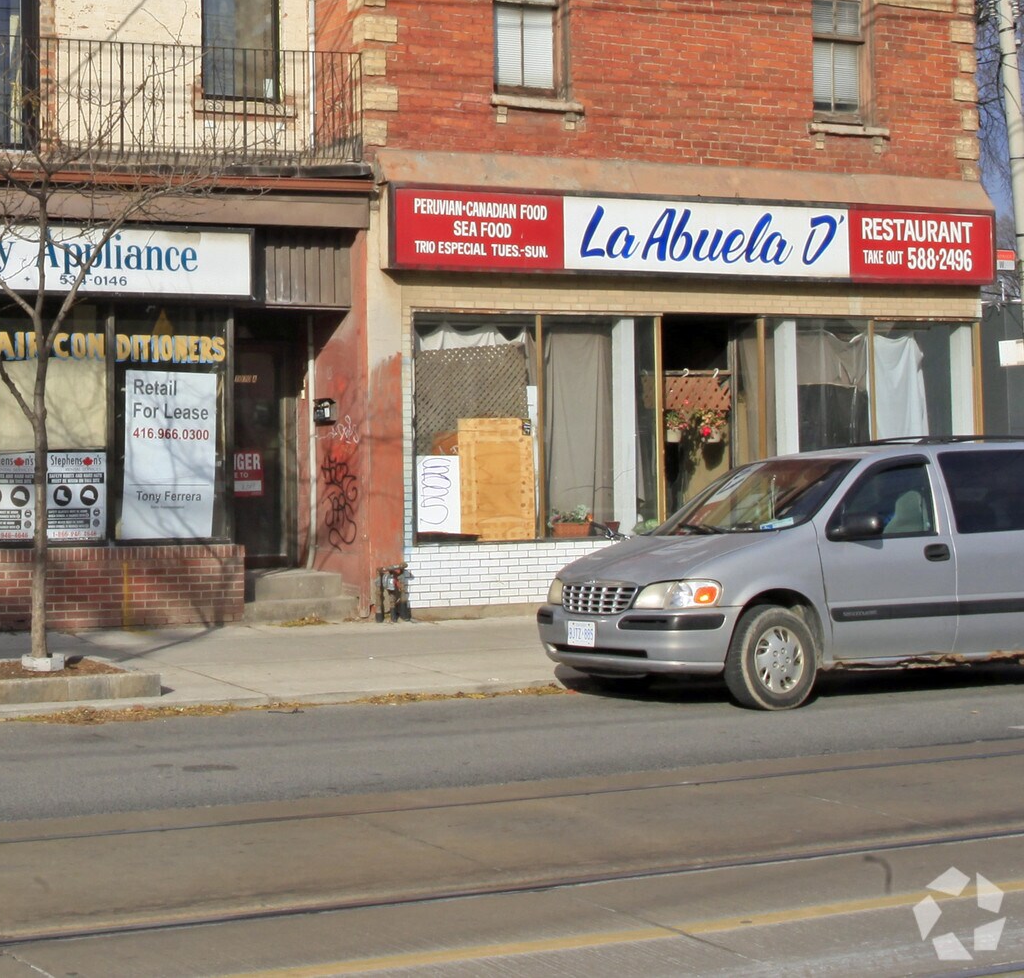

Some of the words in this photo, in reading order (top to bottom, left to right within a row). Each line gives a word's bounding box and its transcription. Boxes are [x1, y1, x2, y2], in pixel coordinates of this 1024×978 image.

[520, 204, 548, 221] FOOD
[453, 220, 478, 237] SEA
[480, 222, 512, 238] FOOD
[580, 205, 640, 260] La
[641, 208, 793, 265] Abuela
[861, 217, 973, 244] RESTAURANT
[36, 226, 198, 275] Appliance
[414, 240, 436, 253] TRIO
[438, 241, 487, 256] ESPECIAL
[863, 250, 884, 264] TAKE
[886, 250, 904, 265] OUT
[133, 378, 177, 396] Retail
[133, 402, 159, 419] For
[164, 403, 209, 420] Lease
[132, 427, 210, 440] 416.966.0300
[50, 454, 102, 468] Stephensn's
[234, 453, 261, 470] GER
[136, 490, 161, 503] Tony
[164, 491, 202, 501] Ferrera
